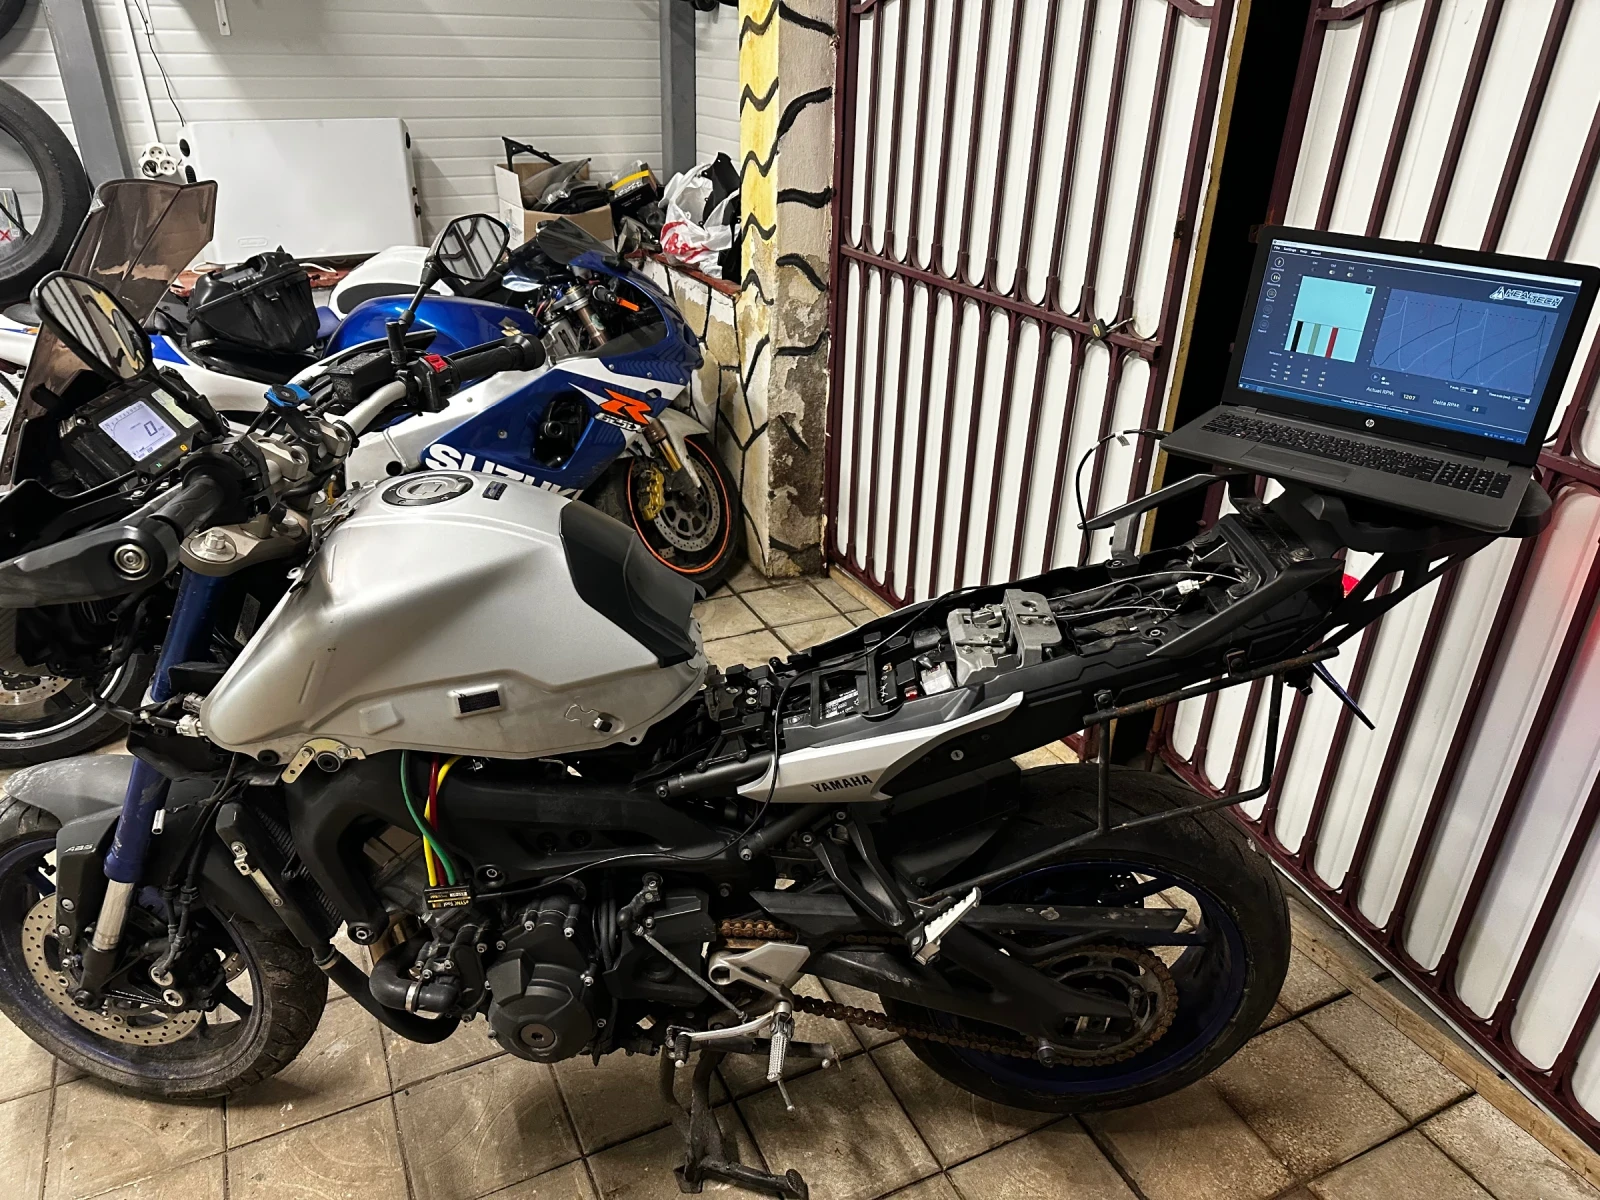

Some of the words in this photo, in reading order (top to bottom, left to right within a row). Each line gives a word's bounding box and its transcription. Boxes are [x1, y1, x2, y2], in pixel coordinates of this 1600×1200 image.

[1366, 386, 1381, 394] Actual
[1365, 419, 1375, 427] hp
[811, 775, 874, 792] YAMAHA
